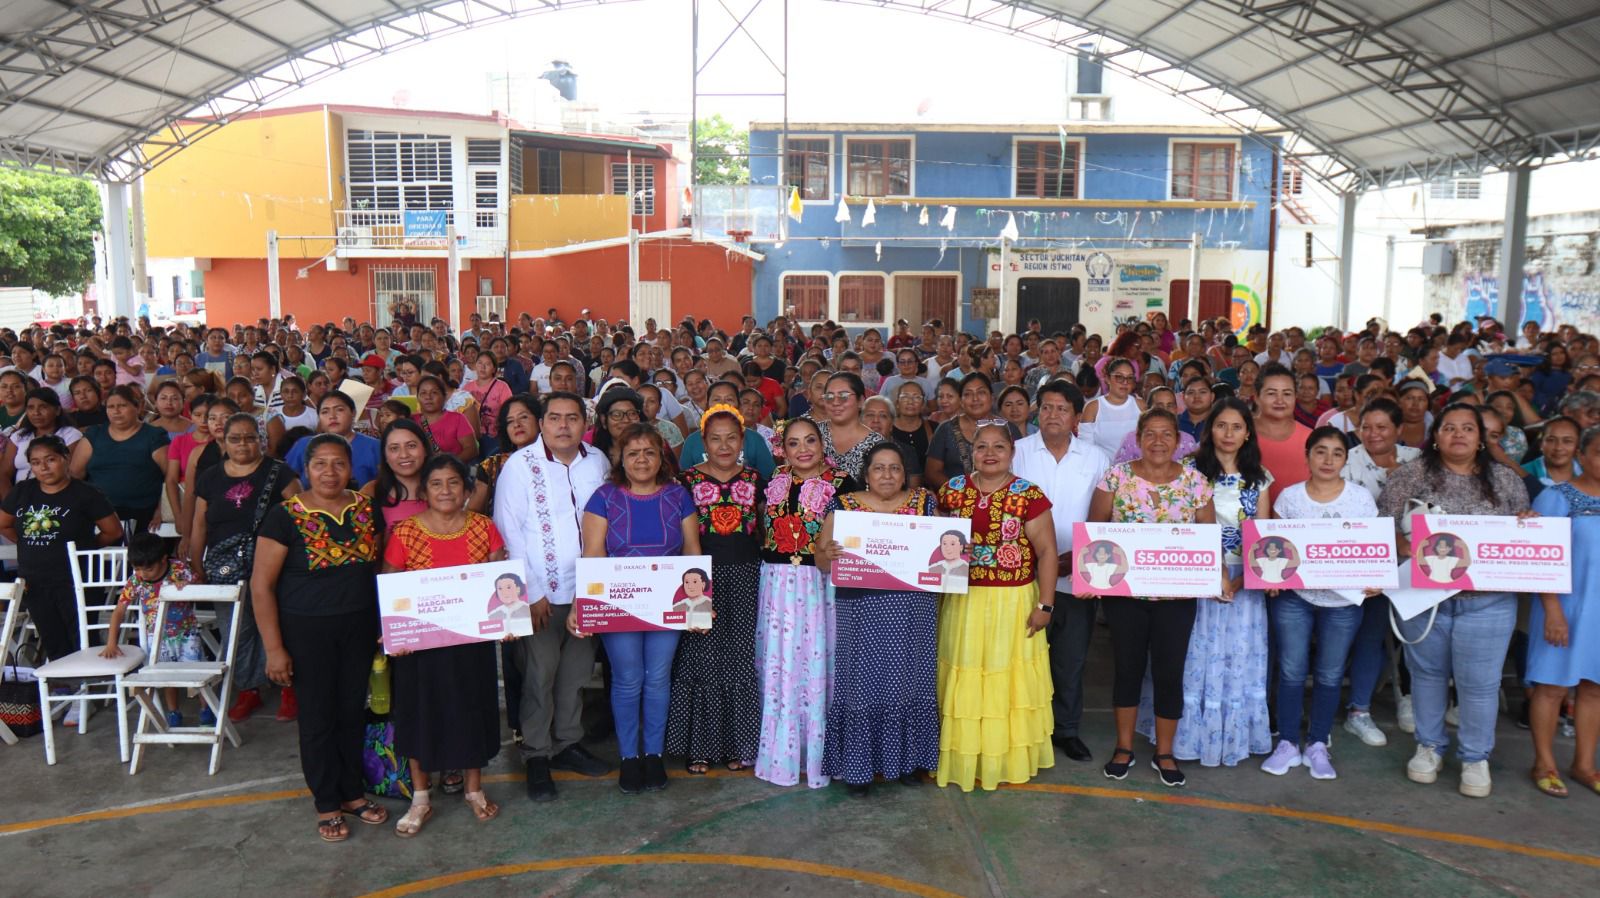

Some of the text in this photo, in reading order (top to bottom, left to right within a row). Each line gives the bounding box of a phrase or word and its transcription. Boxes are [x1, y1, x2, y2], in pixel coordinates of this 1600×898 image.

[1052, 254, 1086, 262] JUCHITAN
[1050, 262, 1072, 271] ISTMO
[16, 504, 70, 518] CAPRI
[1308, 545, 1387, 558] $5,000.00
[1480, 545, 1561, 559] $5,000.00
[1137, 551, 1212, 565] $5,000.00
[417, 598, 464, 608] MARGARITA
[417, 606, 445, 614] MAZA
